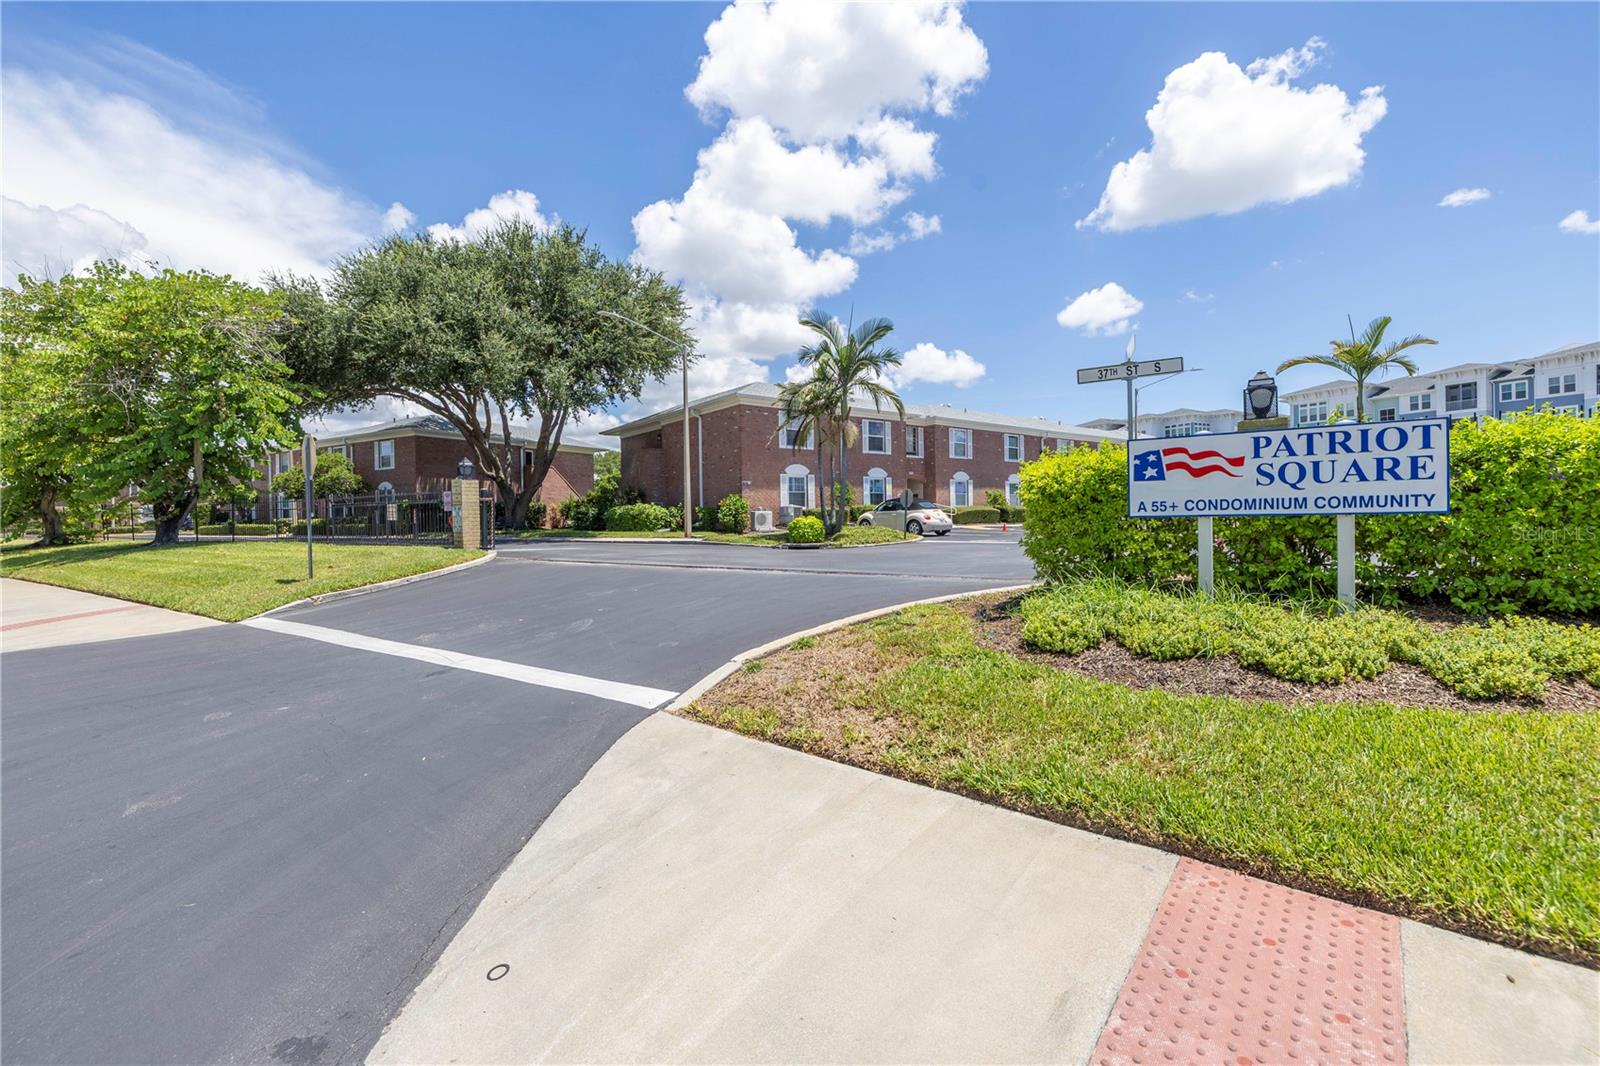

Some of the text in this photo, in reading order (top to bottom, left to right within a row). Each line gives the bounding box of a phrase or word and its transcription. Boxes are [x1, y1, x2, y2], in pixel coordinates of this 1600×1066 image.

[1097, 362, 1161, 379] 37TH ST S
[1250, 423, 1442, 459] PATRIOT
[1255, 454, 1436, 490] SQUARE
[1137, 493, 1436, 513] A 55+ CONDOMINIUM COMMUNITY
